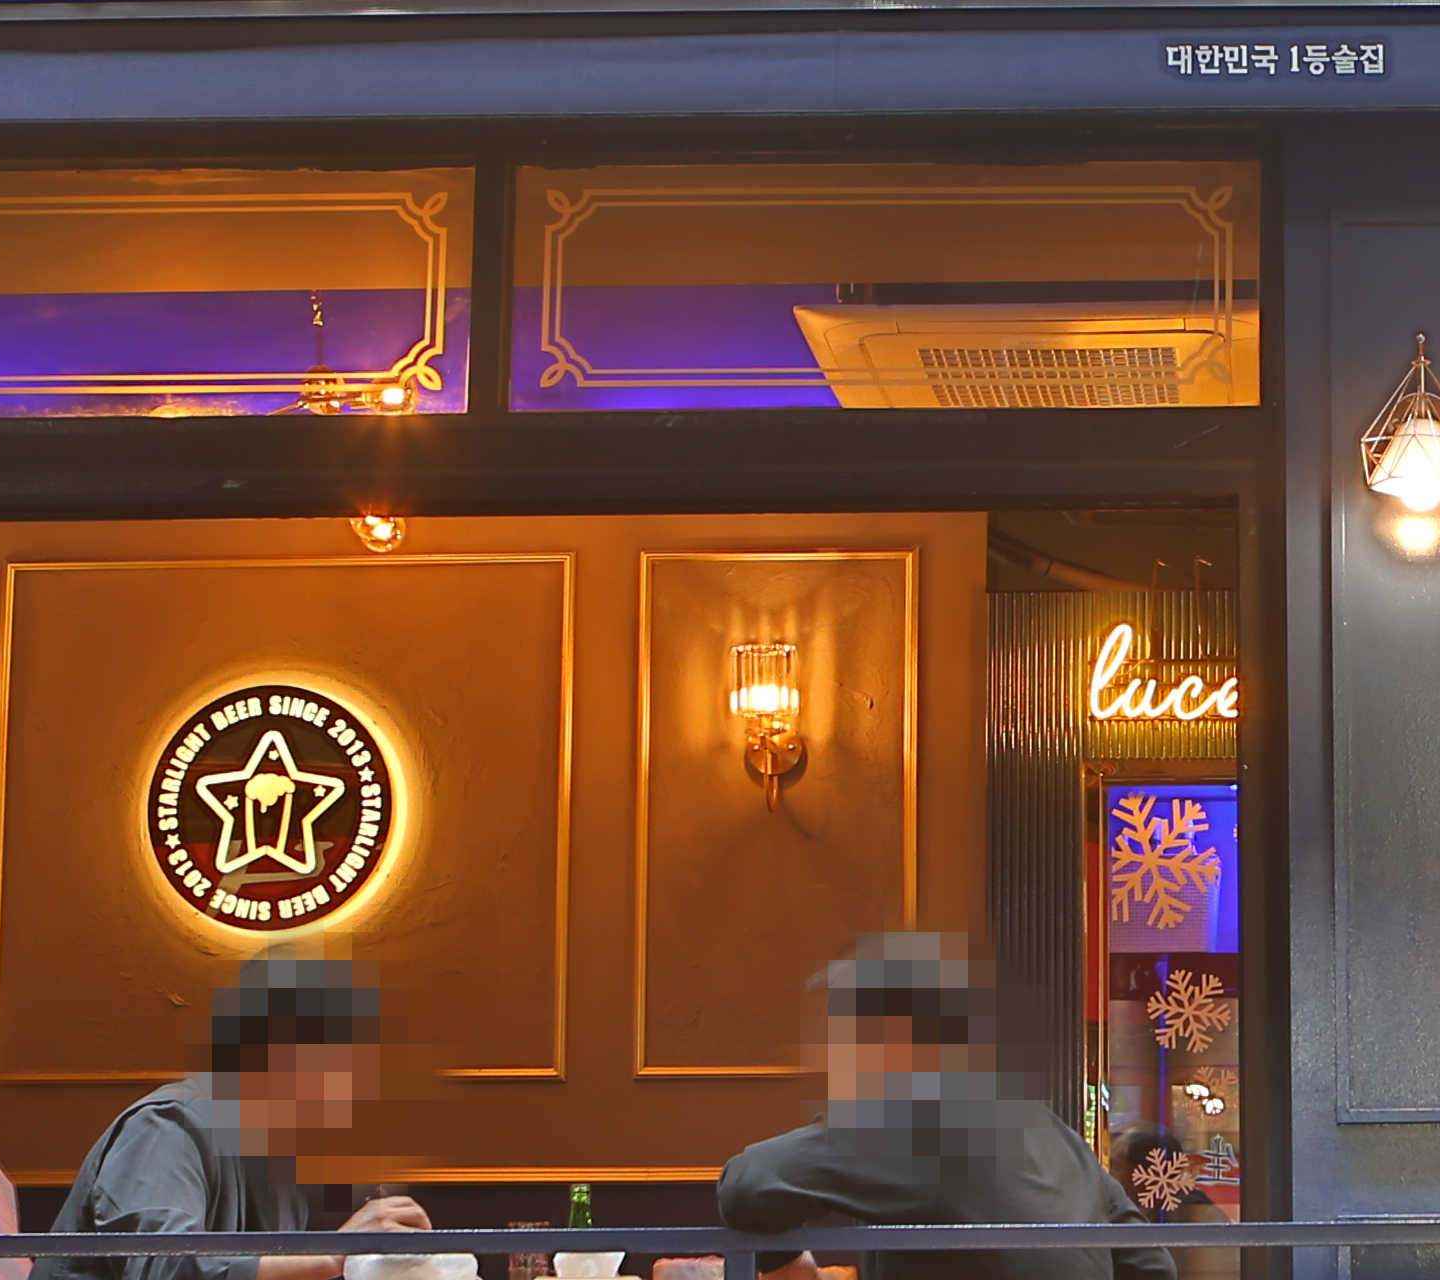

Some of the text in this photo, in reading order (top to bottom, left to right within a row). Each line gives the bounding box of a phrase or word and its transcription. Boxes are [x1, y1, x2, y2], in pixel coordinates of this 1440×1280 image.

[1165, 43, 1277, 76] 대한민국
[1289, 42, 1386, 76] 1등술집
[158, 694, 372, 832] STARLIGHT BEER SINCE 2013
[166, 783, 383, 921] STARLIGHT BEER SINCE 2013
